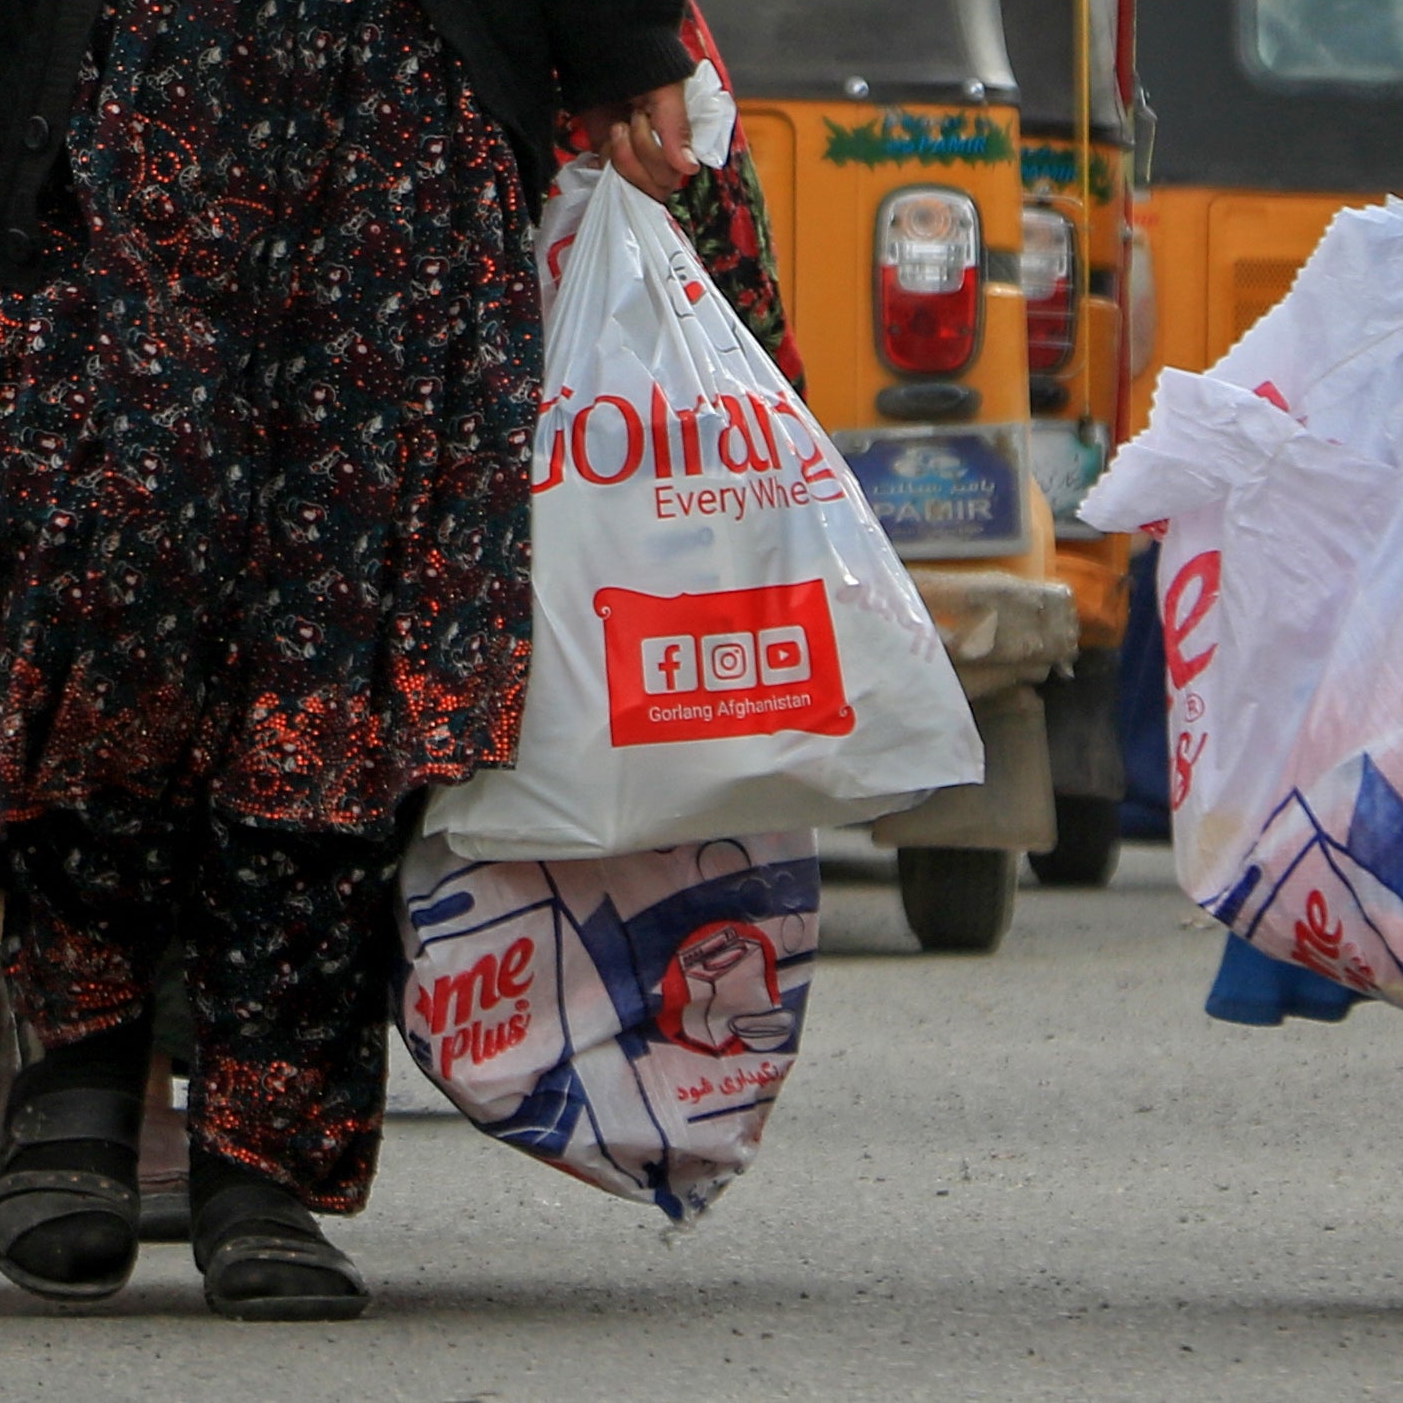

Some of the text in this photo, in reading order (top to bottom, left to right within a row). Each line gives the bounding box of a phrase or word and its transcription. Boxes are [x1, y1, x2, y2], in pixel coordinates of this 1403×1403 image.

[749, 476, 810, 509] Whe
[872, 499, 994, 523] PAMIR
[649, 693, 812, 722] Gorlang Afghanistan
[415, 936, 536, 1036] me
